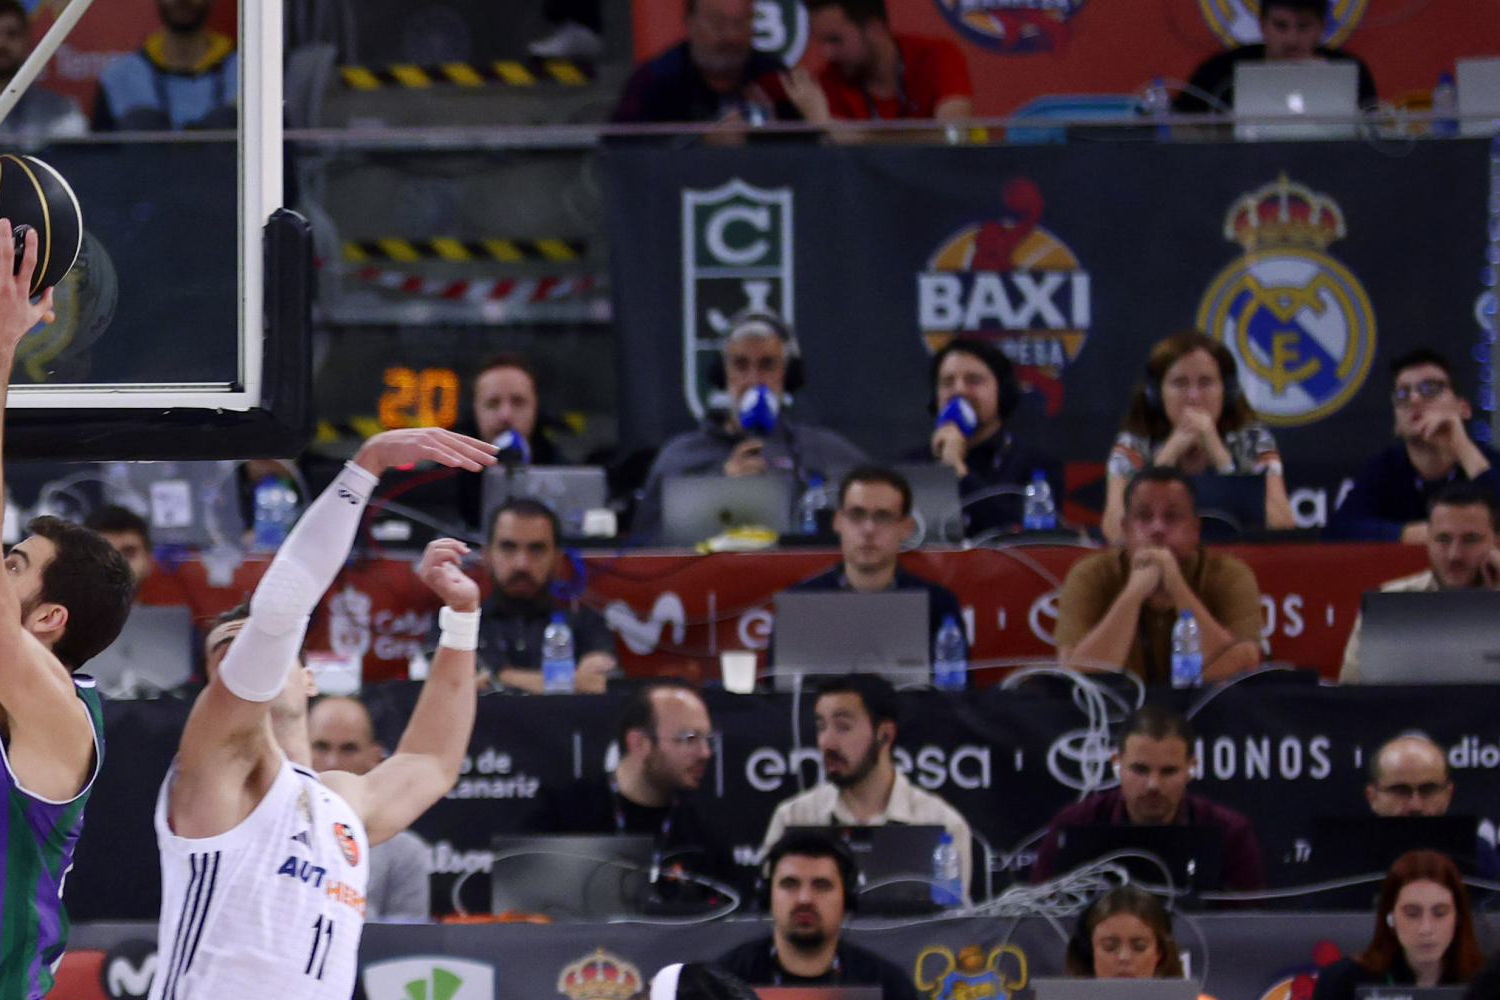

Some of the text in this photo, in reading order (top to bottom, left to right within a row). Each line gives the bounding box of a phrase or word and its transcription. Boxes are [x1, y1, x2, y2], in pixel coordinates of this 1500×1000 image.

[918, 272, 1092, 332] BAXI
[1194, 736, 1332, 781] IONOS
[305, 914, 334, 980] 11
